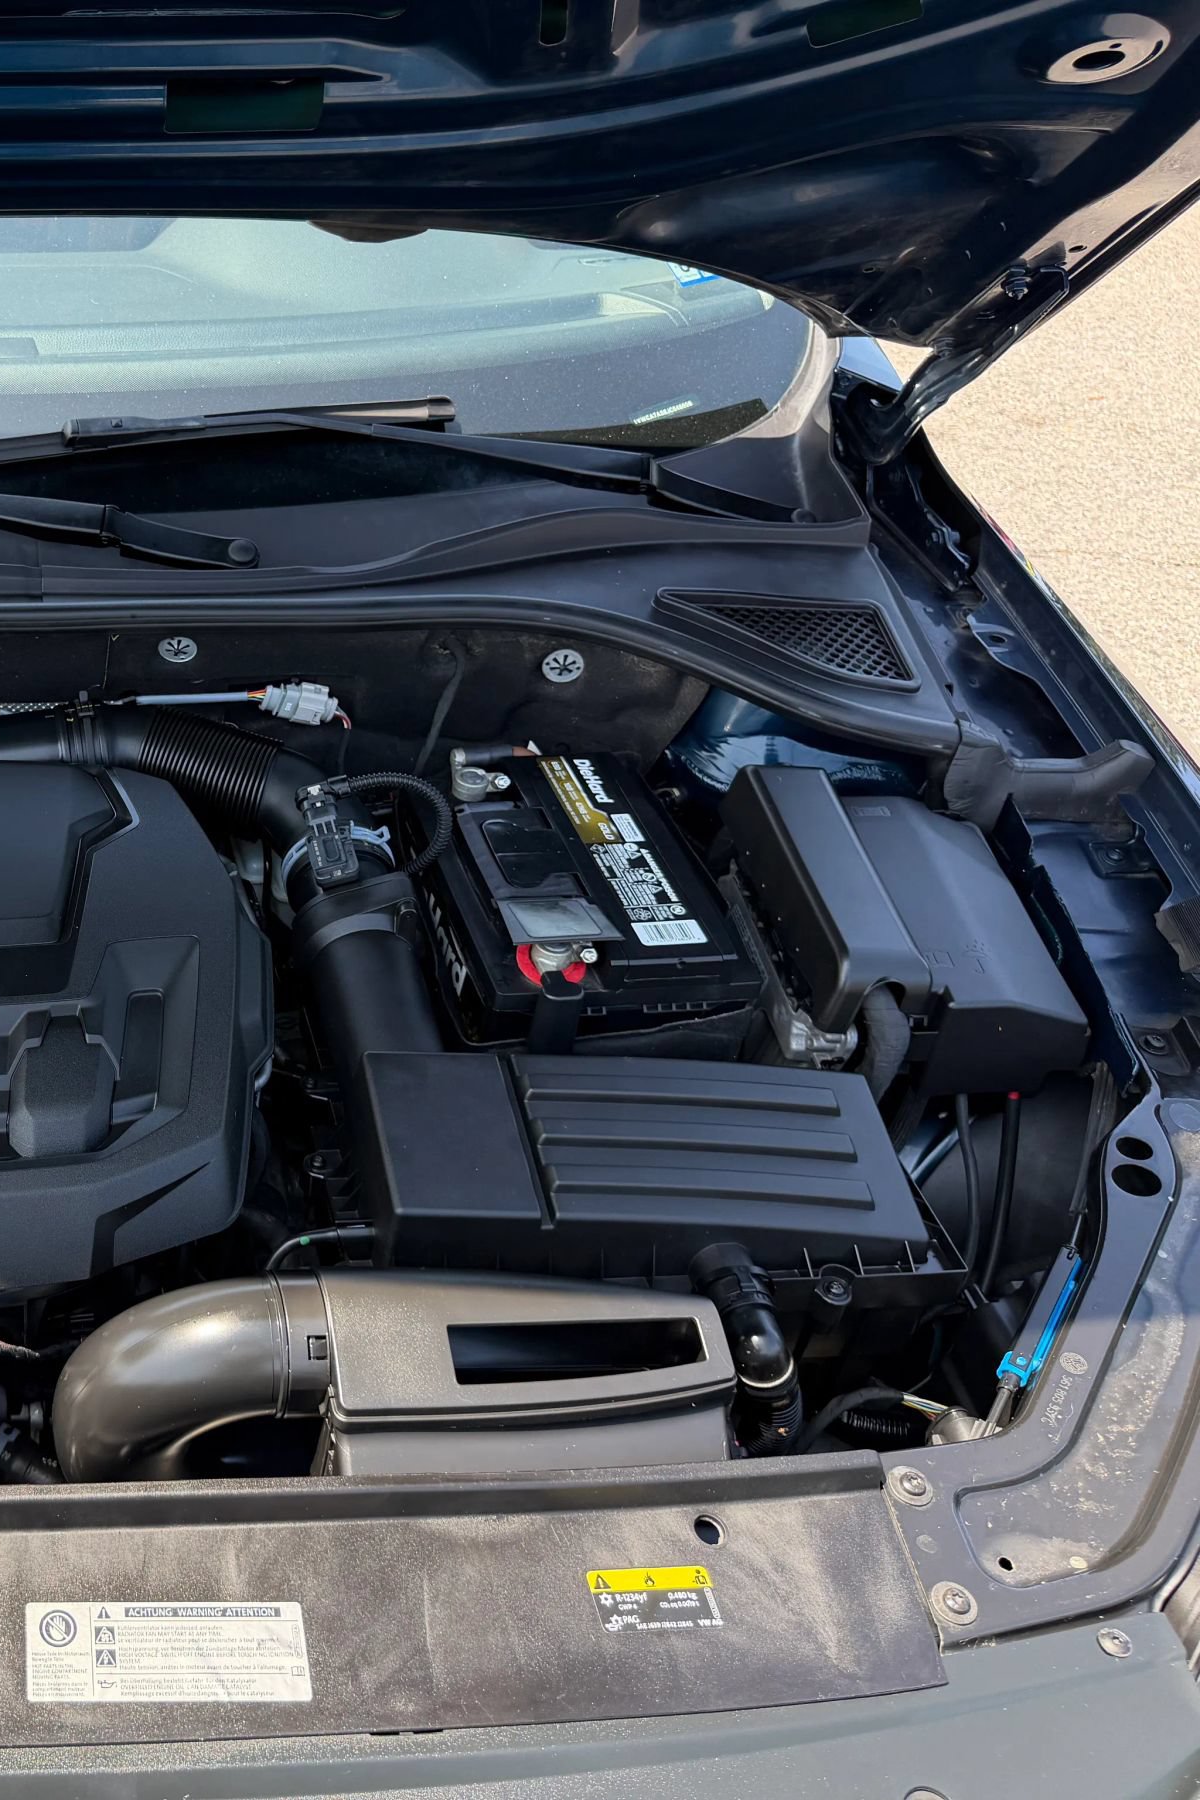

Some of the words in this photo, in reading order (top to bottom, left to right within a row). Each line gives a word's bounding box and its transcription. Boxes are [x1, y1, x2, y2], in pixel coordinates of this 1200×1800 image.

[573, 759, 615, 804] DieHard
[597, 822, 616, 841] GOLD
[1060, 1375, 1073, 1390] 561
[1052, 1388, 1066, 1404] 805
[615, 1591, 647, 1604] R-1234yf
[686, 1590, 698, 1601] kg
[128, 1606, 173, 1617] ACHTUNG
[176, 1606, 222, 1617] WARNING
[225, 1606, 275, 1617] ATTENTION
[622, 1614, 640, 1624] PAG
[635, 1622, 648, 1630] SAE
[698, 1618, 711, 1627] VW
[711, 1618, 724, 1626] AG
